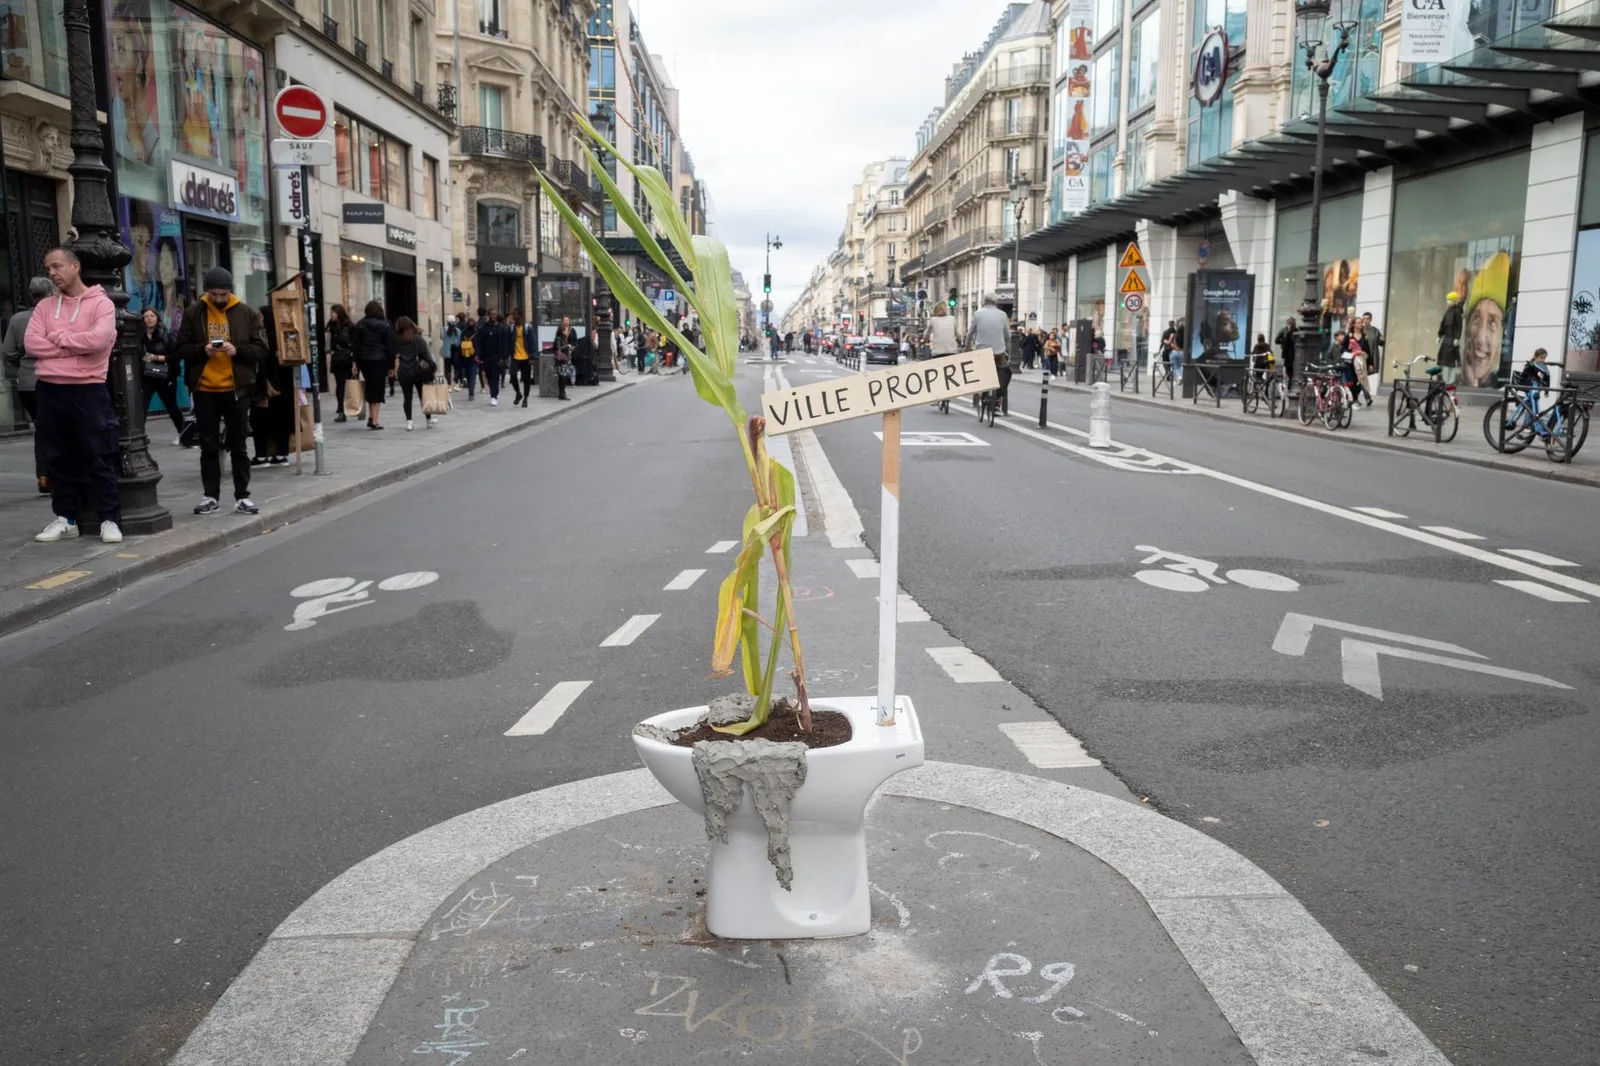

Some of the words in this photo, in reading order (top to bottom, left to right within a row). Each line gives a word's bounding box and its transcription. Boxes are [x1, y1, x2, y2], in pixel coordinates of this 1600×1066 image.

[1407, 12, 1445, 20] Bienvenue
[288, 171, 302, 219] claire's
[494, 261, 526, 274] Bershka
[1203, 289, 1223, 297] Google
[1129, 299, 1139, 307] 30
[868, 360, 981, 407] PROPRE
